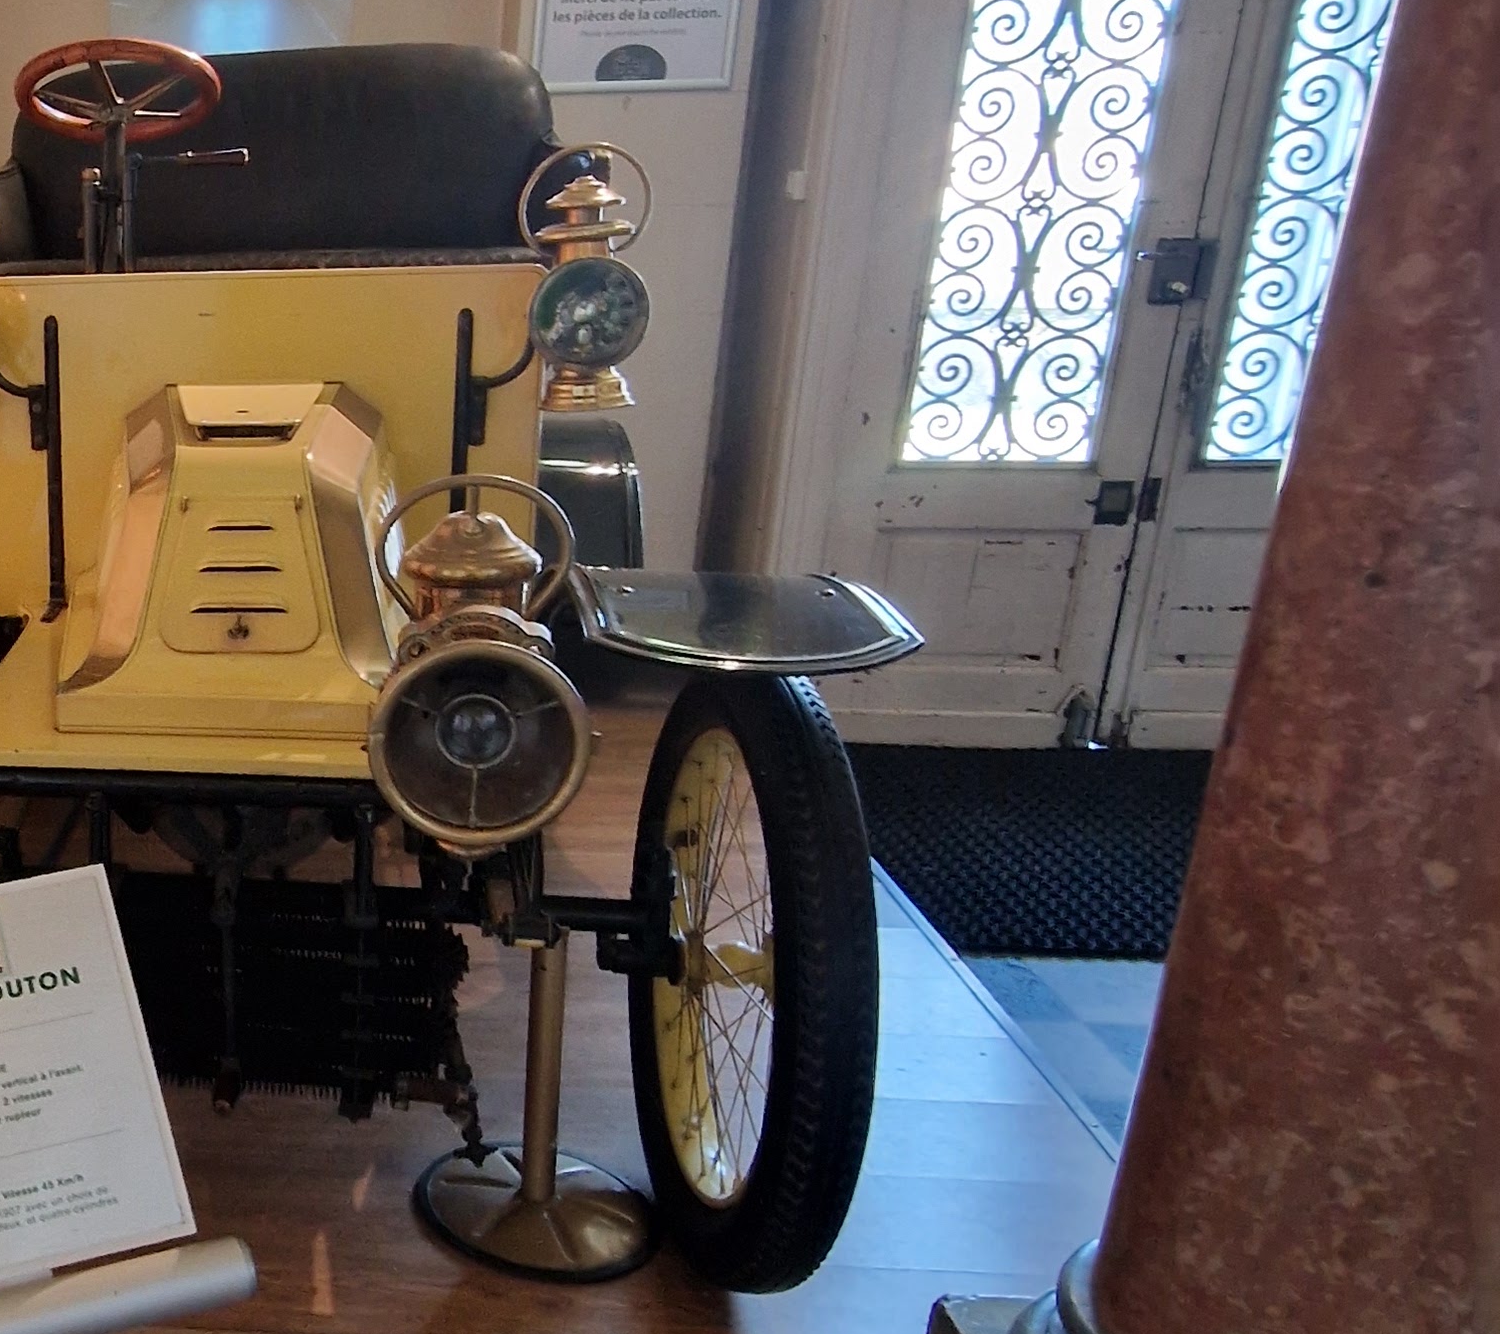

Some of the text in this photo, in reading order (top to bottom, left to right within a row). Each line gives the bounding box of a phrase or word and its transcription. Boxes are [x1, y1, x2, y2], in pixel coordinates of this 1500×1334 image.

[552, 6, 723, 25] les pièces de la collection.
[2, 1074, 38, 1089] vertical
[12, 1090, 53, 1104] vitesses
